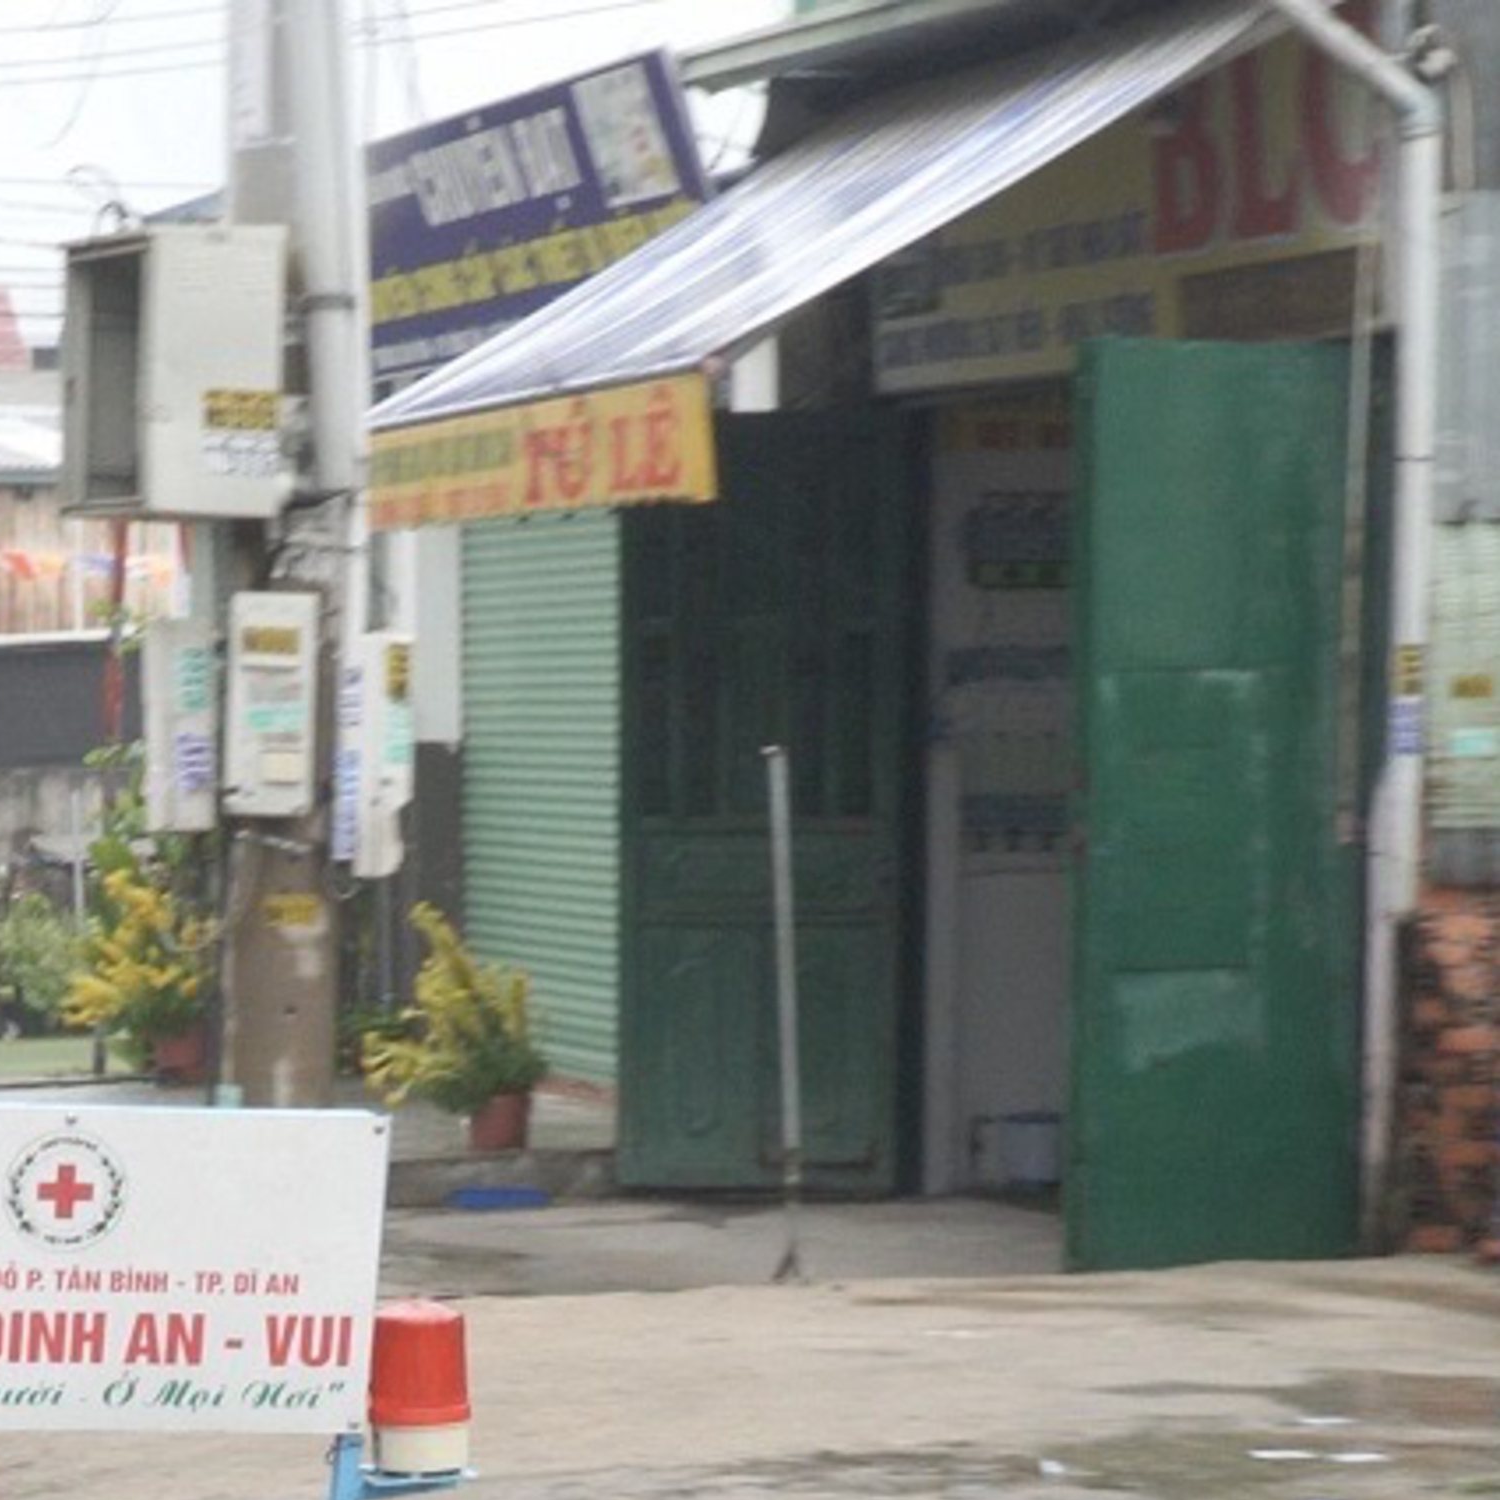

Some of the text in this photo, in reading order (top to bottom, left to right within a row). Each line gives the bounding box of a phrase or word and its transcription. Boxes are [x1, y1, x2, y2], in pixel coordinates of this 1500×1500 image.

[26, 1267, 46, 1291] P.
[55, 1264, 101, 1292] TÂN
[195, 1271, 226, 1295] TP.
[265, 1274, 300, 1296] AN
[124, 1312, 206, 1366] AN
[224, 1337, 244, 1350] -
[265, 1315, 353, 1368] VUI
[151, 1378, 226, 1413] Mọi
